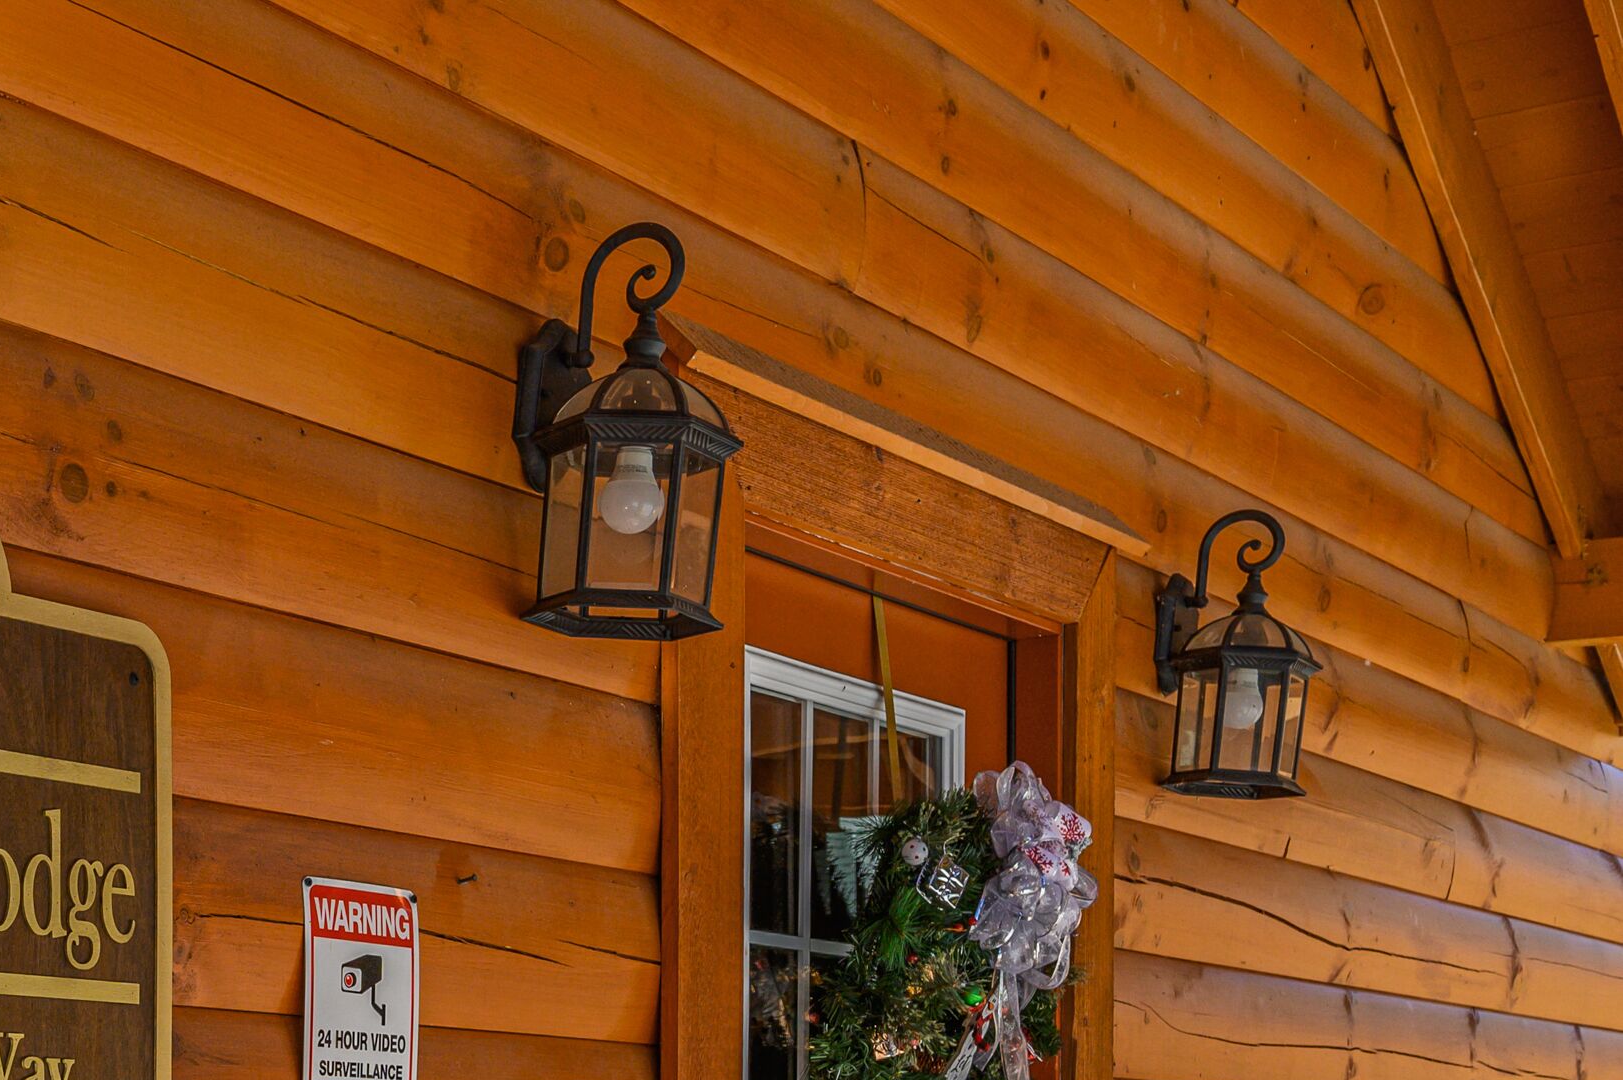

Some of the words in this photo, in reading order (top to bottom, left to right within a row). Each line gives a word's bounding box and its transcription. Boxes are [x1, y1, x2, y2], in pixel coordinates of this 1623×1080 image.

[314, 896, 410, 940] WARNING
[317, 1029, 332, 1048] 24
[336, 1030, 368, 1051] HOUR
[371, 1033, 406, 1054] VIDEO
[319, 1060, 403, 1080] SURVEILLANCE
